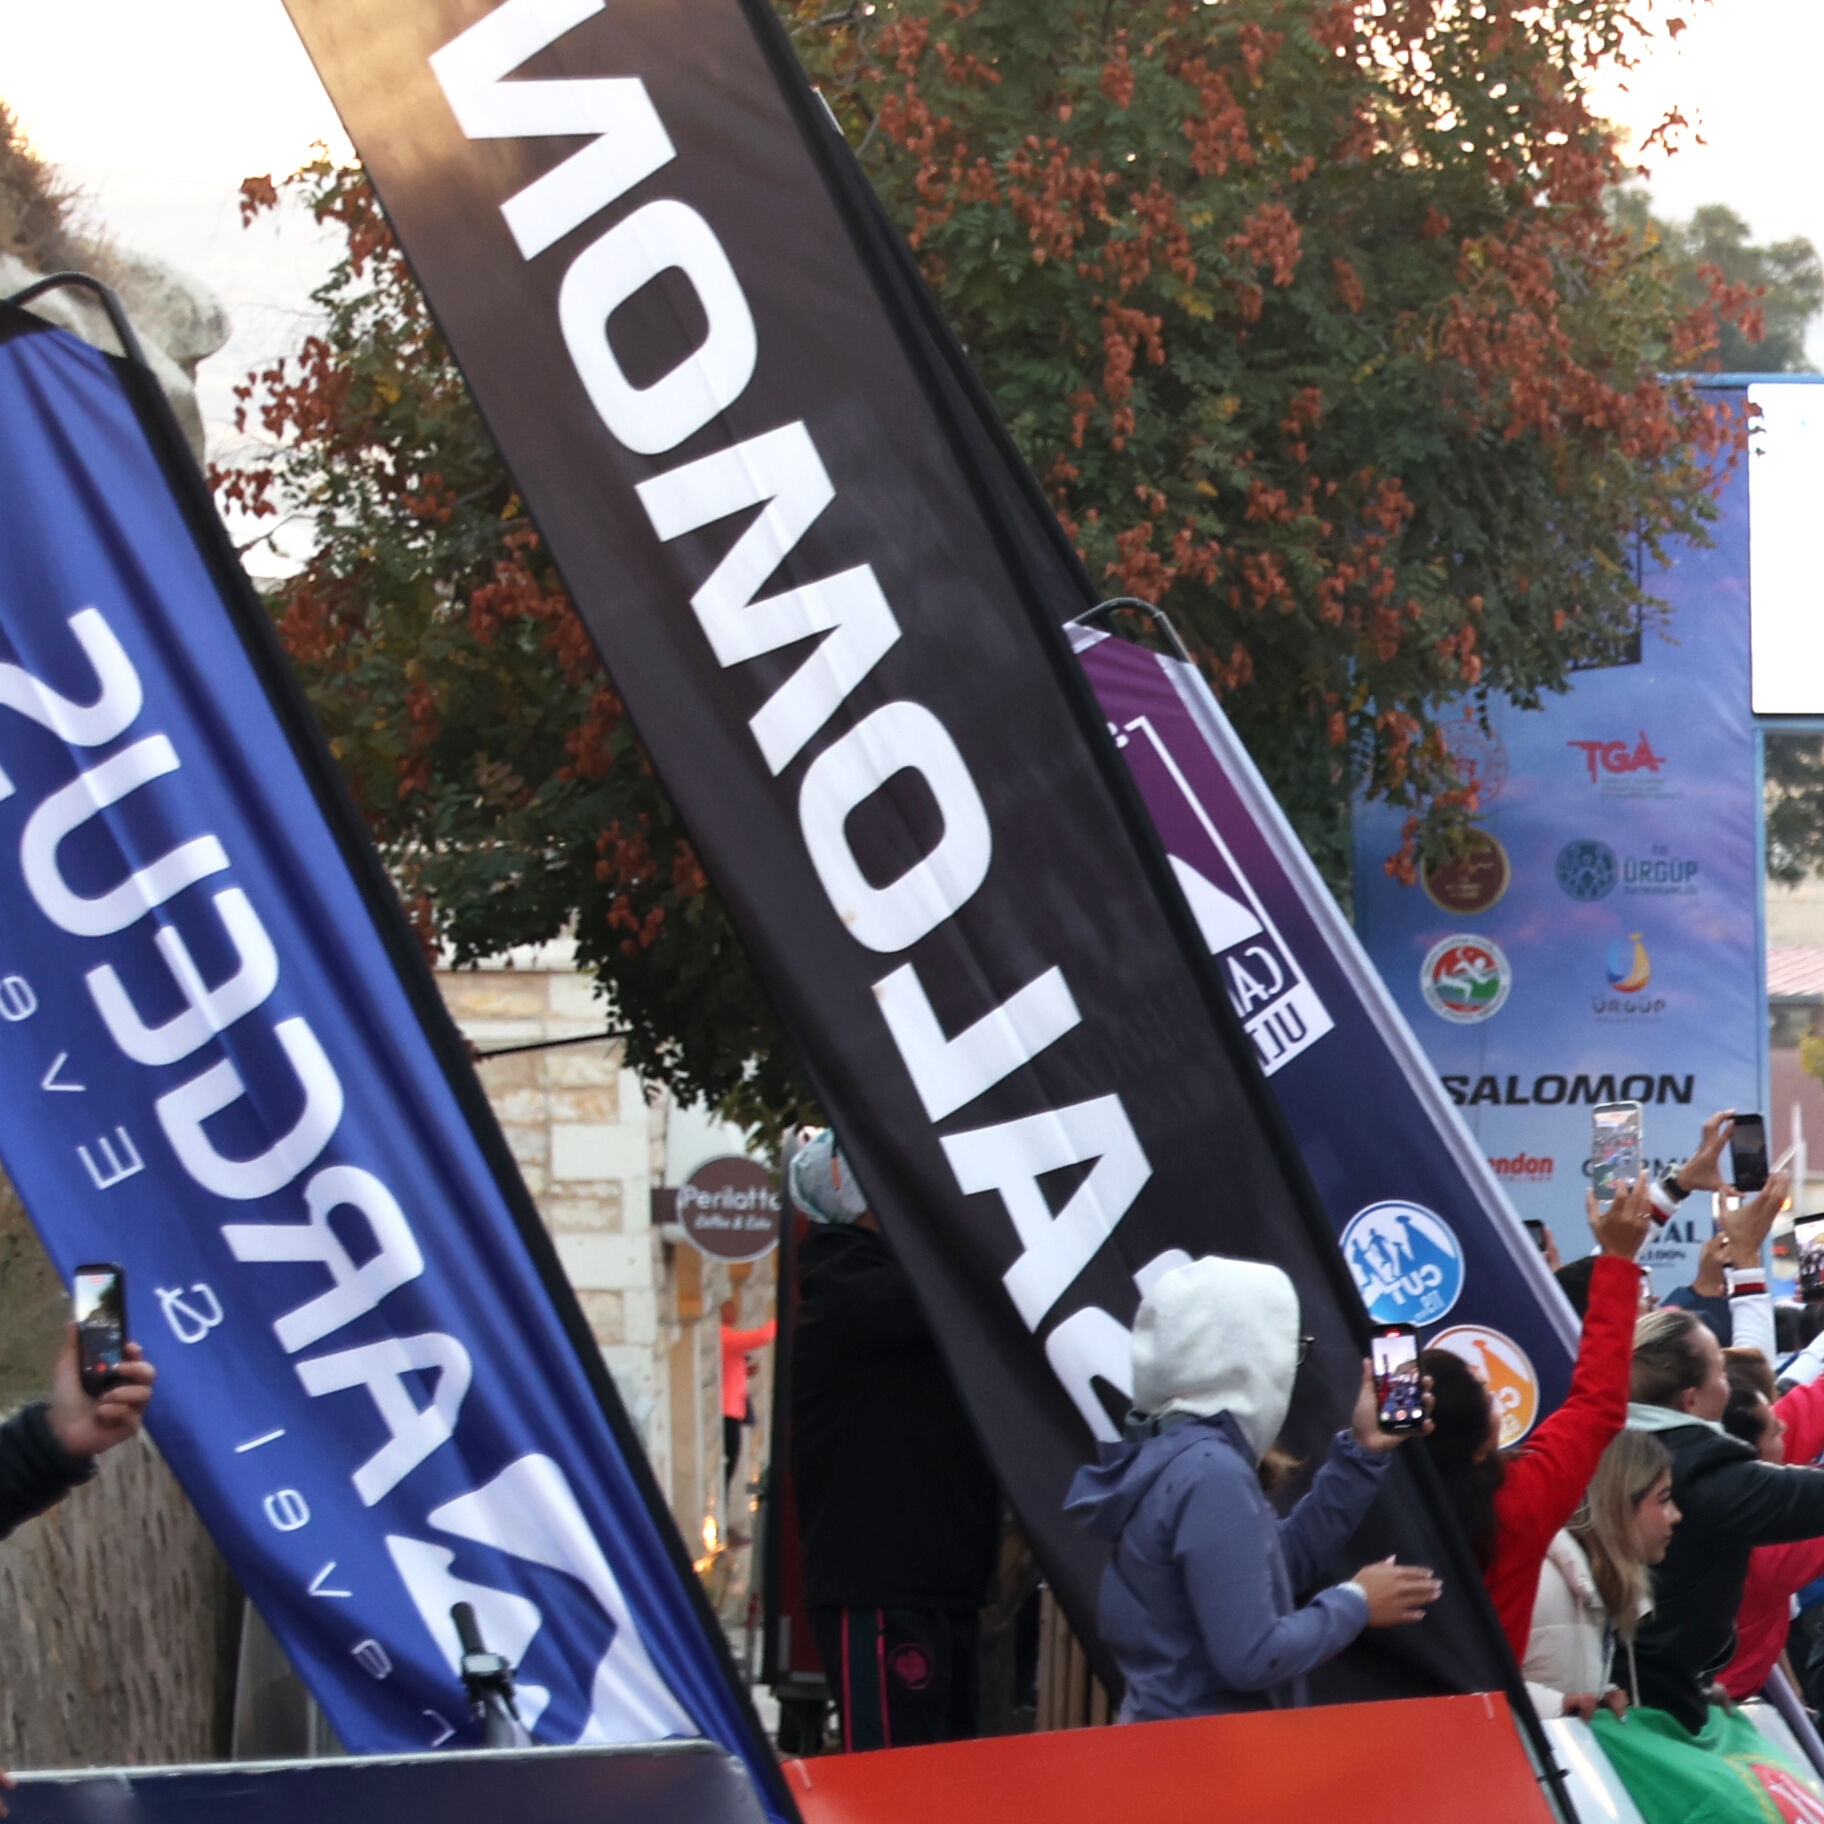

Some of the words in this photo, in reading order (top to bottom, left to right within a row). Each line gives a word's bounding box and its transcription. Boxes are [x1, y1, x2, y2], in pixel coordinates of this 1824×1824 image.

[1566, 730, 1667, 784] TGA
[1623, 857, 1699, 883] ÜRGÜP
[1441, 1073, 1695, 1106] SALOMON
